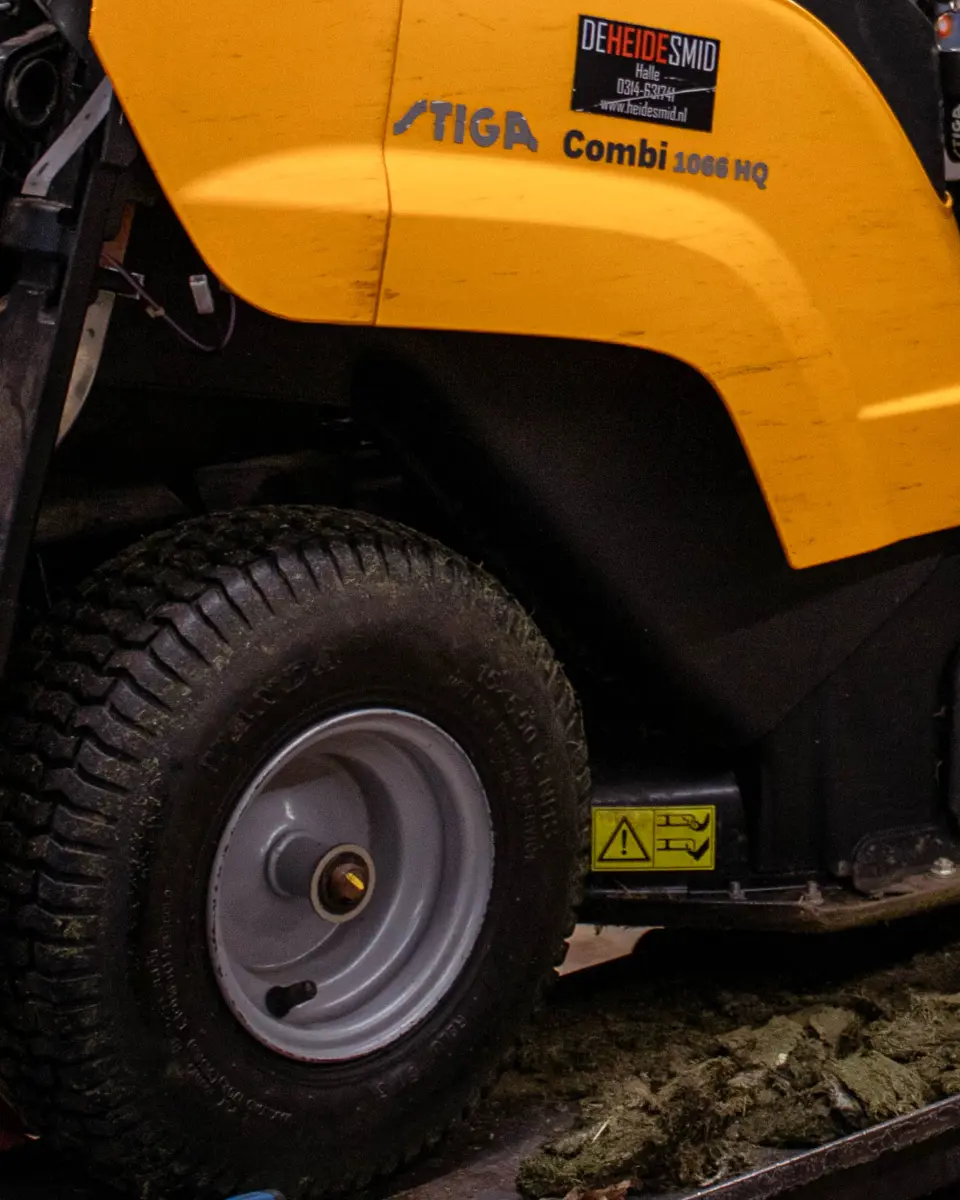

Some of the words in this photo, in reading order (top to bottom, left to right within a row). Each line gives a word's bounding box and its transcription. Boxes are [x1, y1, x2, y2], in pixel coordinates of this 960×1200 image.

[635, 62, 660, 81] Halle
[393, 99, 539, 153] STIGA
[600, 99, 688, 123] www.heidesmid.nl
[563, 129, 668, 170] Combi
[673, 151, 728, 178] 1066
[733, 158, 768, 190] HQ
